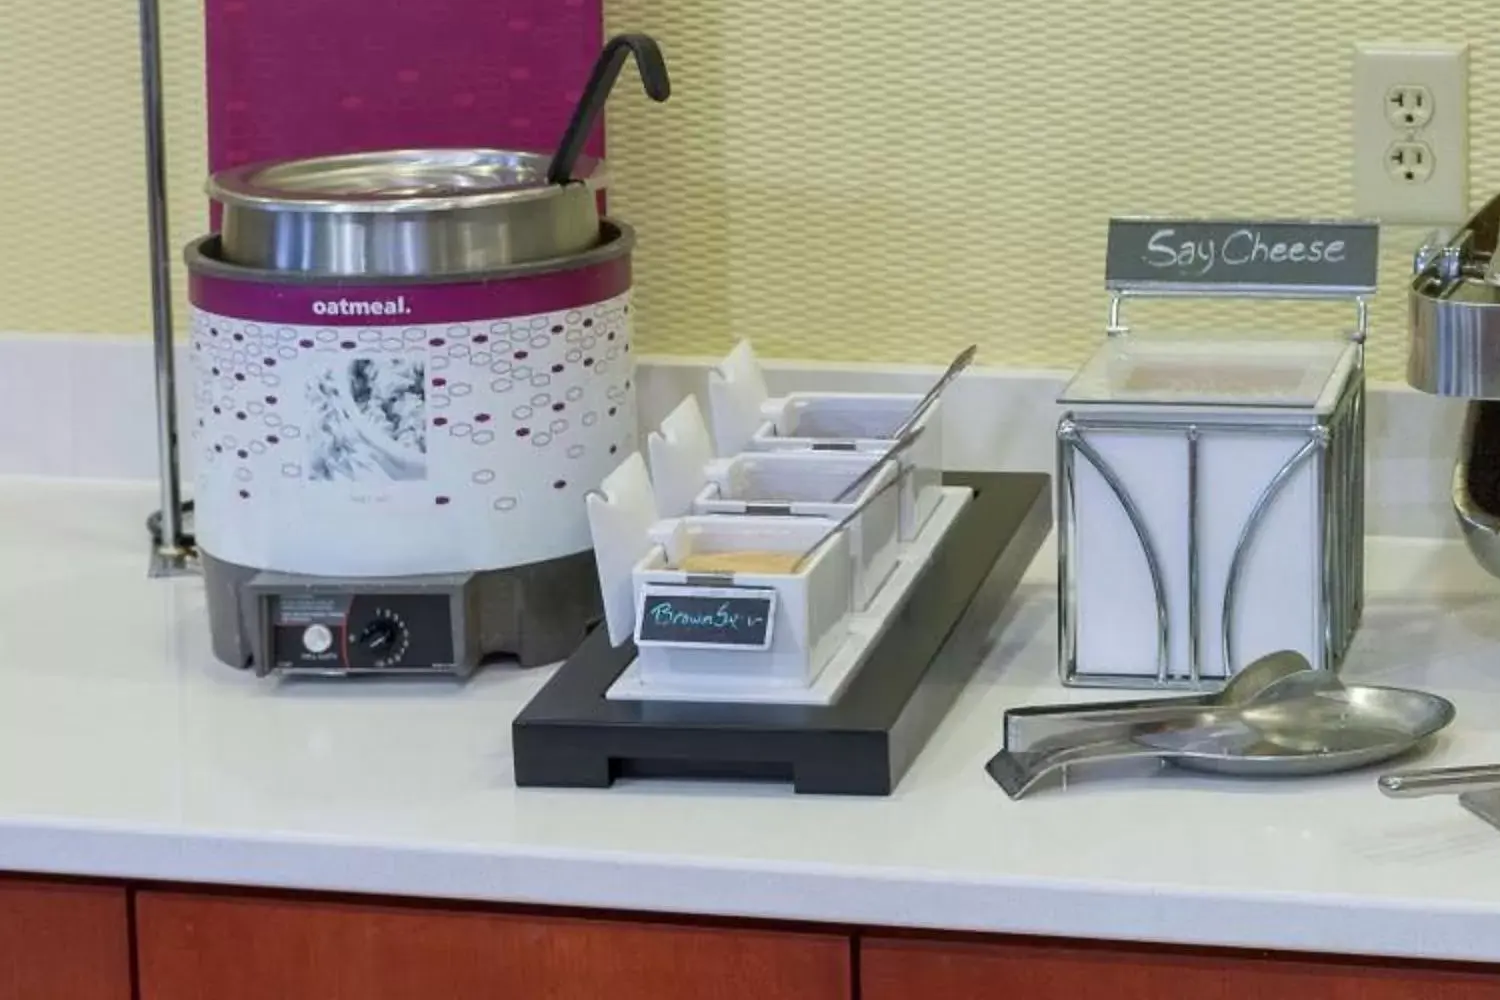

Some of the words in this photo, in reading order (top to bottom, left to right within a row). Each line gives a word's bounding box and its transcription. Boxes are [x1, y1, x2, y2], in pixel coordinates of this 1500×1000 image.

[1145, 229, 1215, 275] Say
[1221, 230, 1345, 265] Cheese
[312, 296, 412, 316] oatmeal.
[650, 602, 713, 626] Brown
